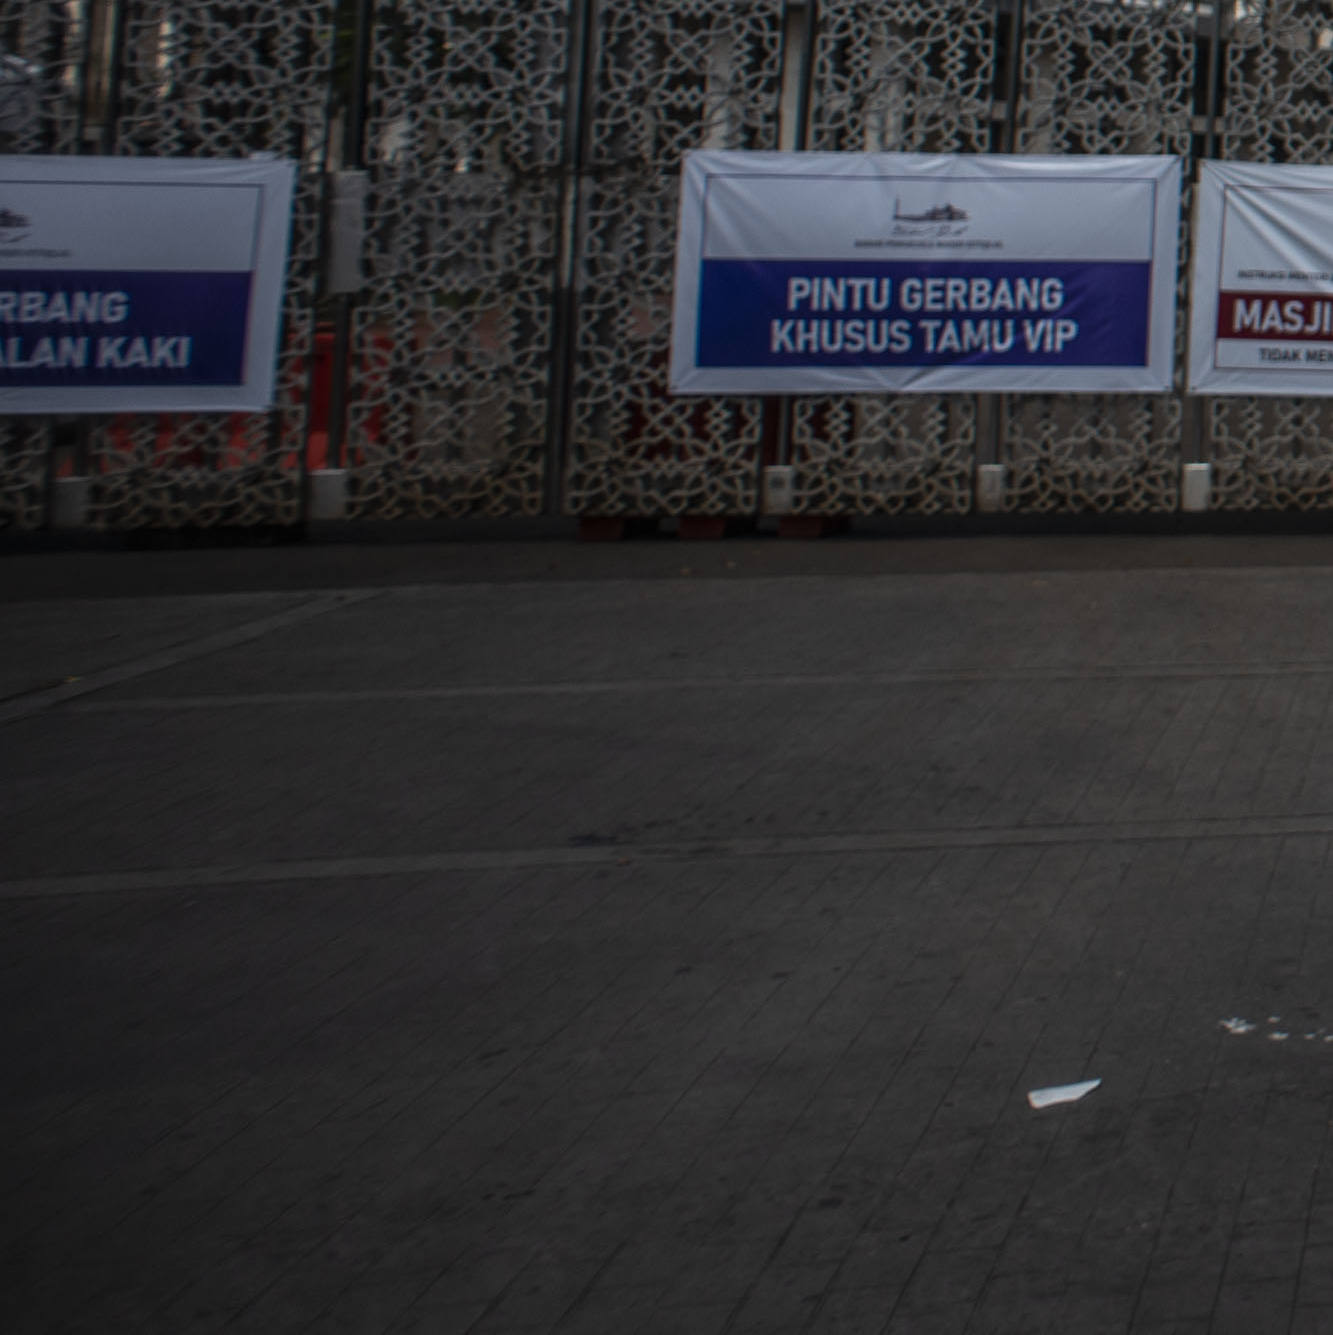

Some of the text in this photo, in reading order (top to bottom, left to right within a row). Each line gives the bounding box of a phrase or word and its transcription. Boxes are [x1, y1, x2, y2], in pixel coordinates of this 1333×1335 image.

[787, 277, 1065, 313] PINTU GERBANG
[0, 335, 192, 368] LAN KAKI
[769, 319, 1079, 354] KHUSUS TAMU VIP
[1259, 348, 1301, 362] TIDAK
